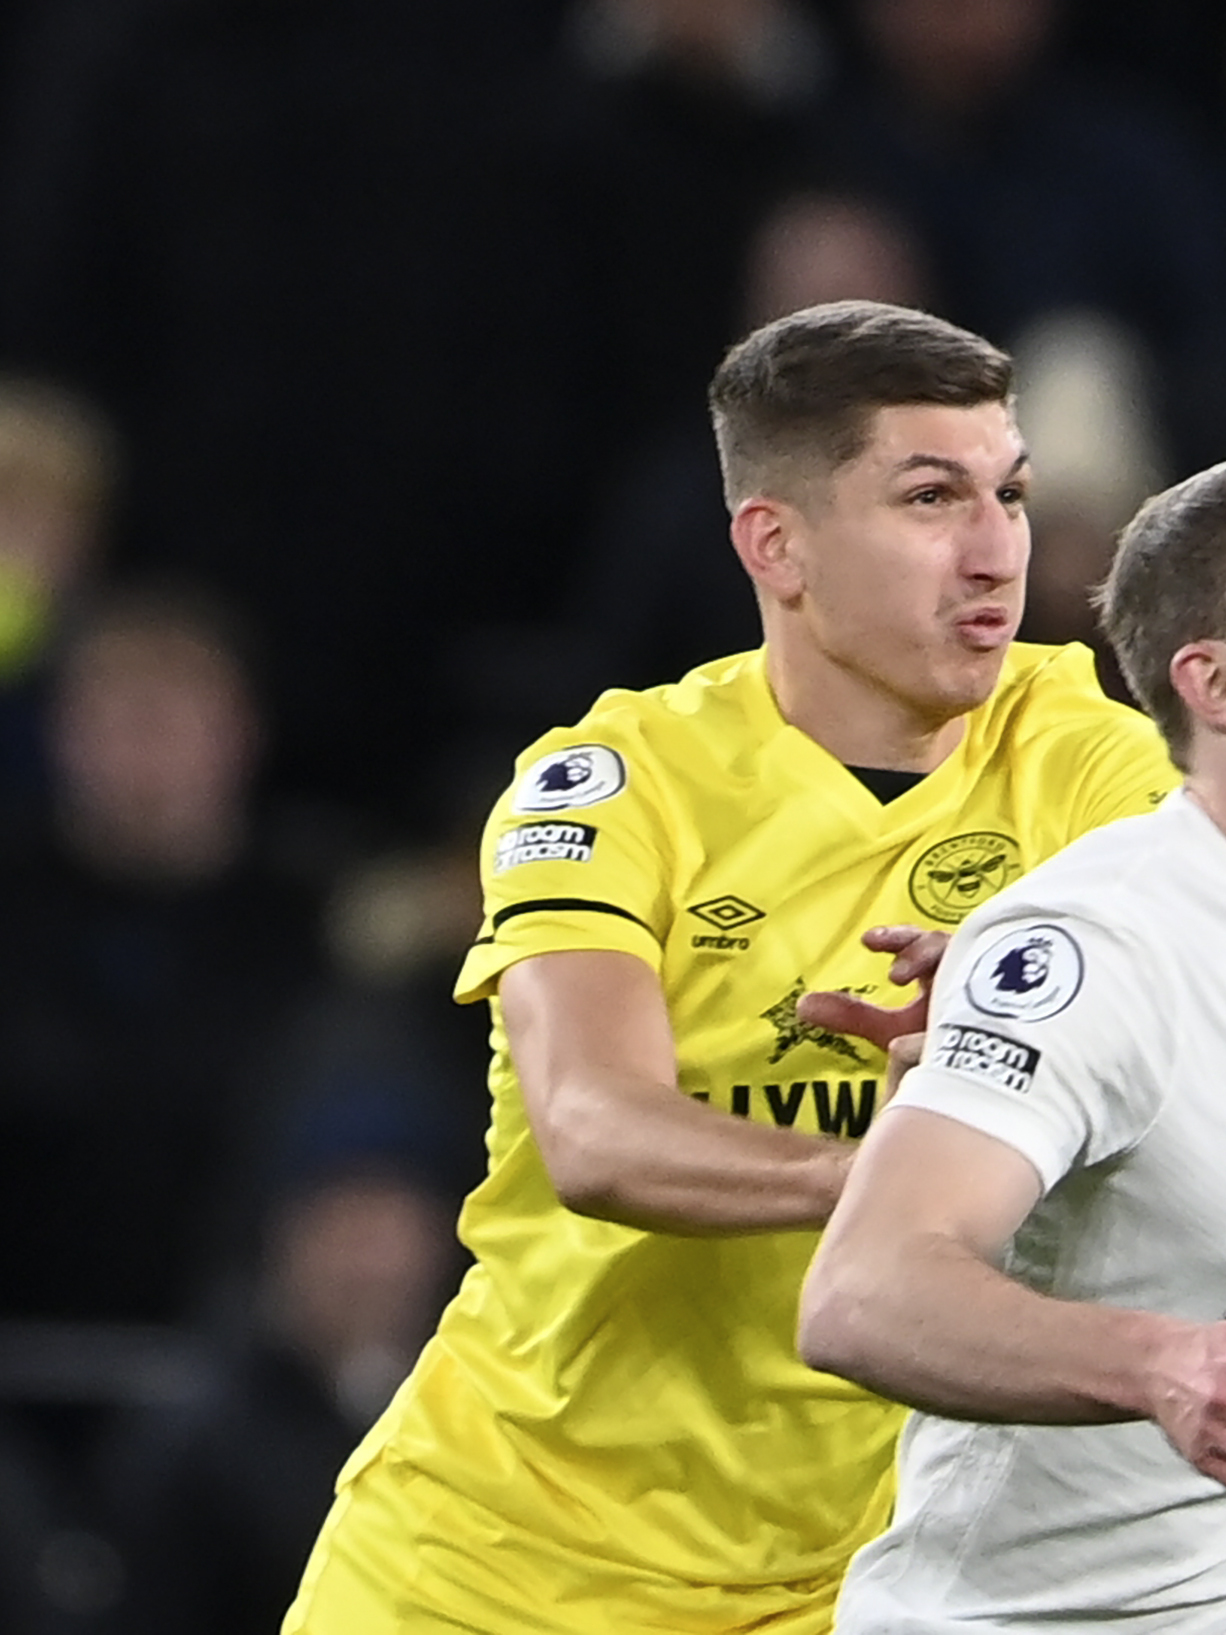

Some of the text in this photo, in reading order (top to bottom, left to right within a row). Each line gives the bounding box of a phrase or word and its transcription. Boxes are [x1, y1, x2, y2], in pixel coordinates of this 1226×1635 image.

[517, 825, 585, 846] room
[691, 934, 750, 951] umbro
[959, 1031, 1029, 1069] room
